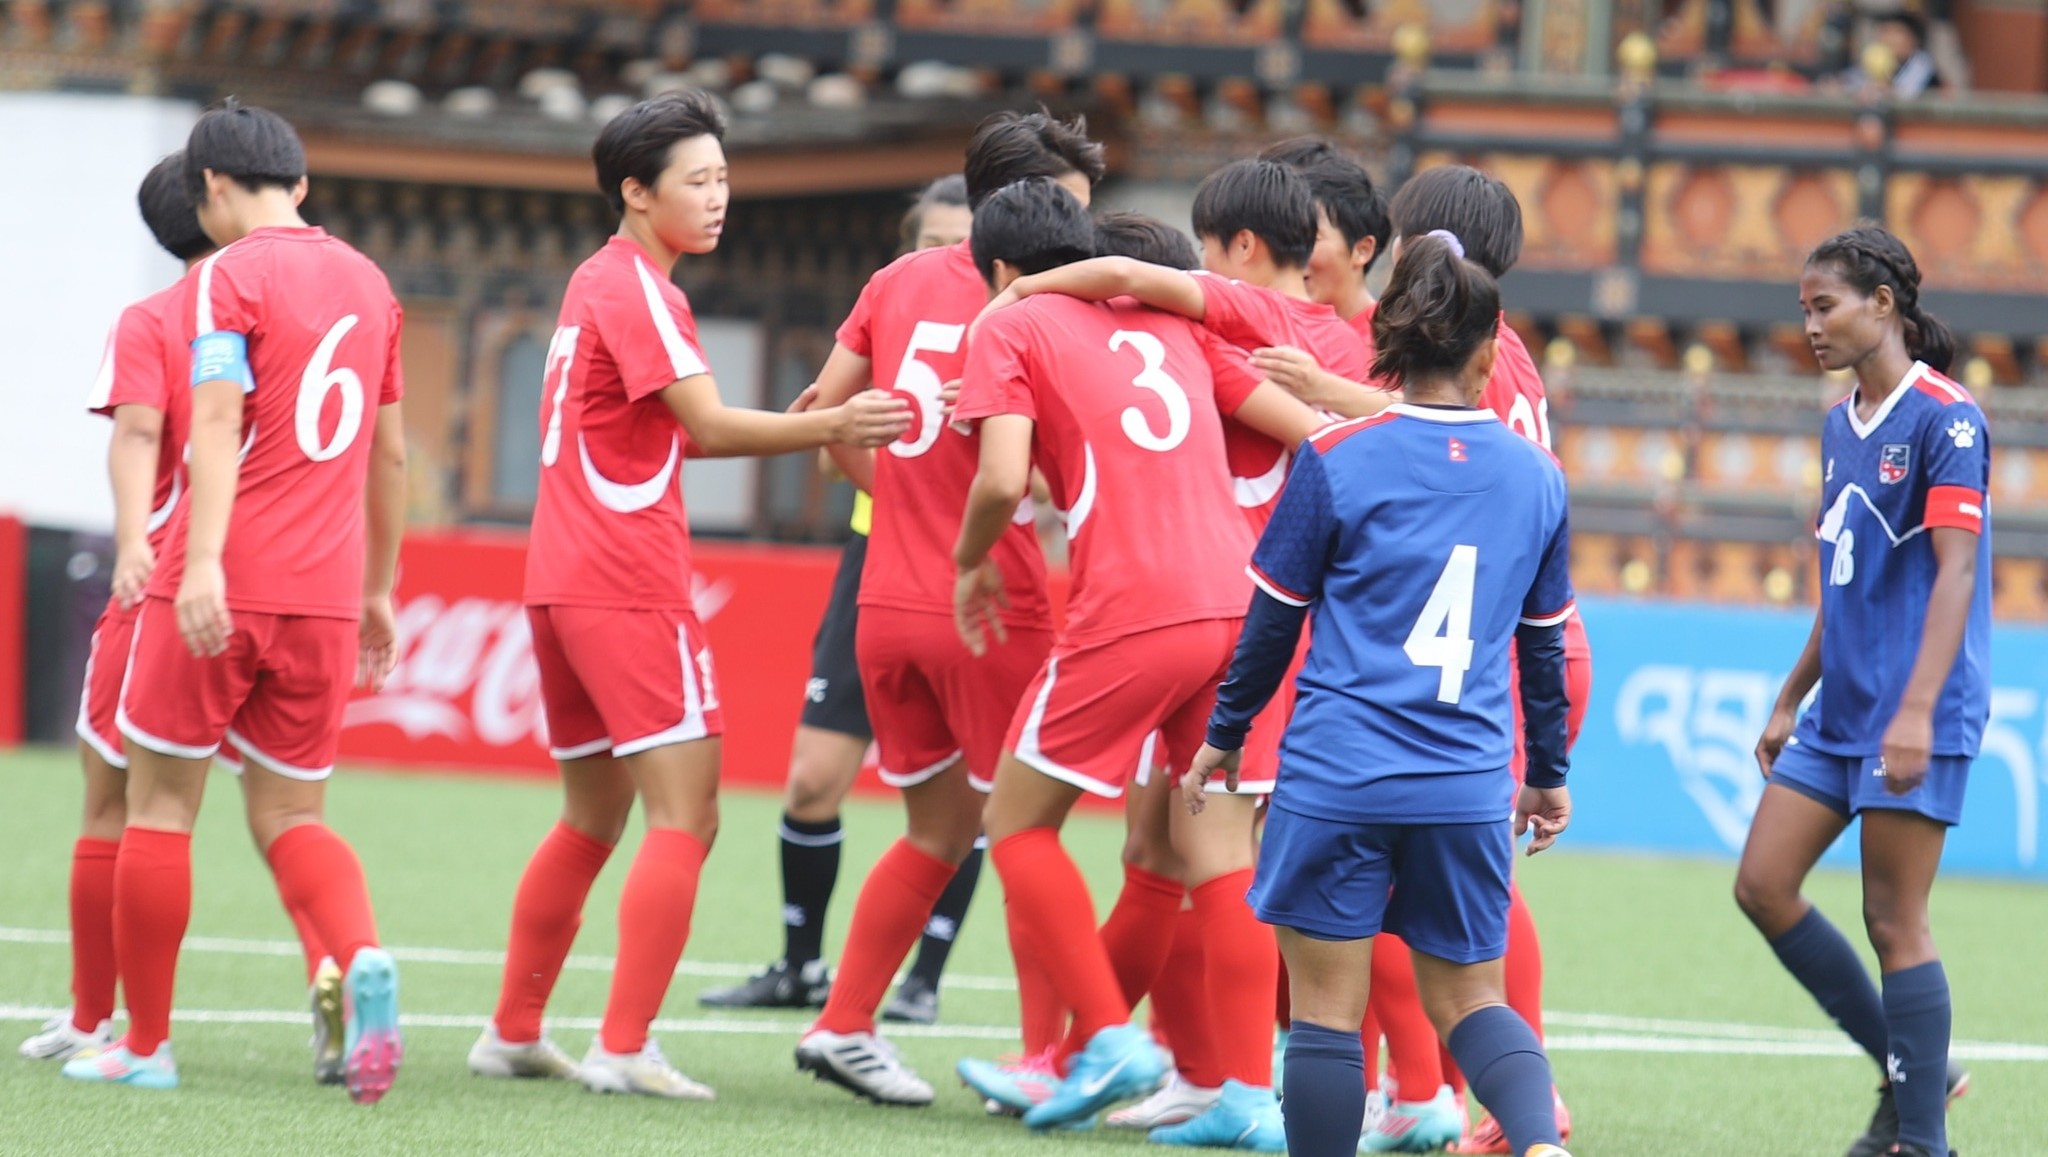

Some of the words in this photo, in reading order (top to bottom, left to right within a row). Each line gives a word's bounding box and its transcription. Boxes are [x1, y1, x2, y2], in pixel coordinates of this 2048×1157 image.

[295, 313, 364, 462] 6
[888, 321, 966, 458] 5
[1108, 329, 1191, 452] 3
[1403, 544, 1478, 705] 4
